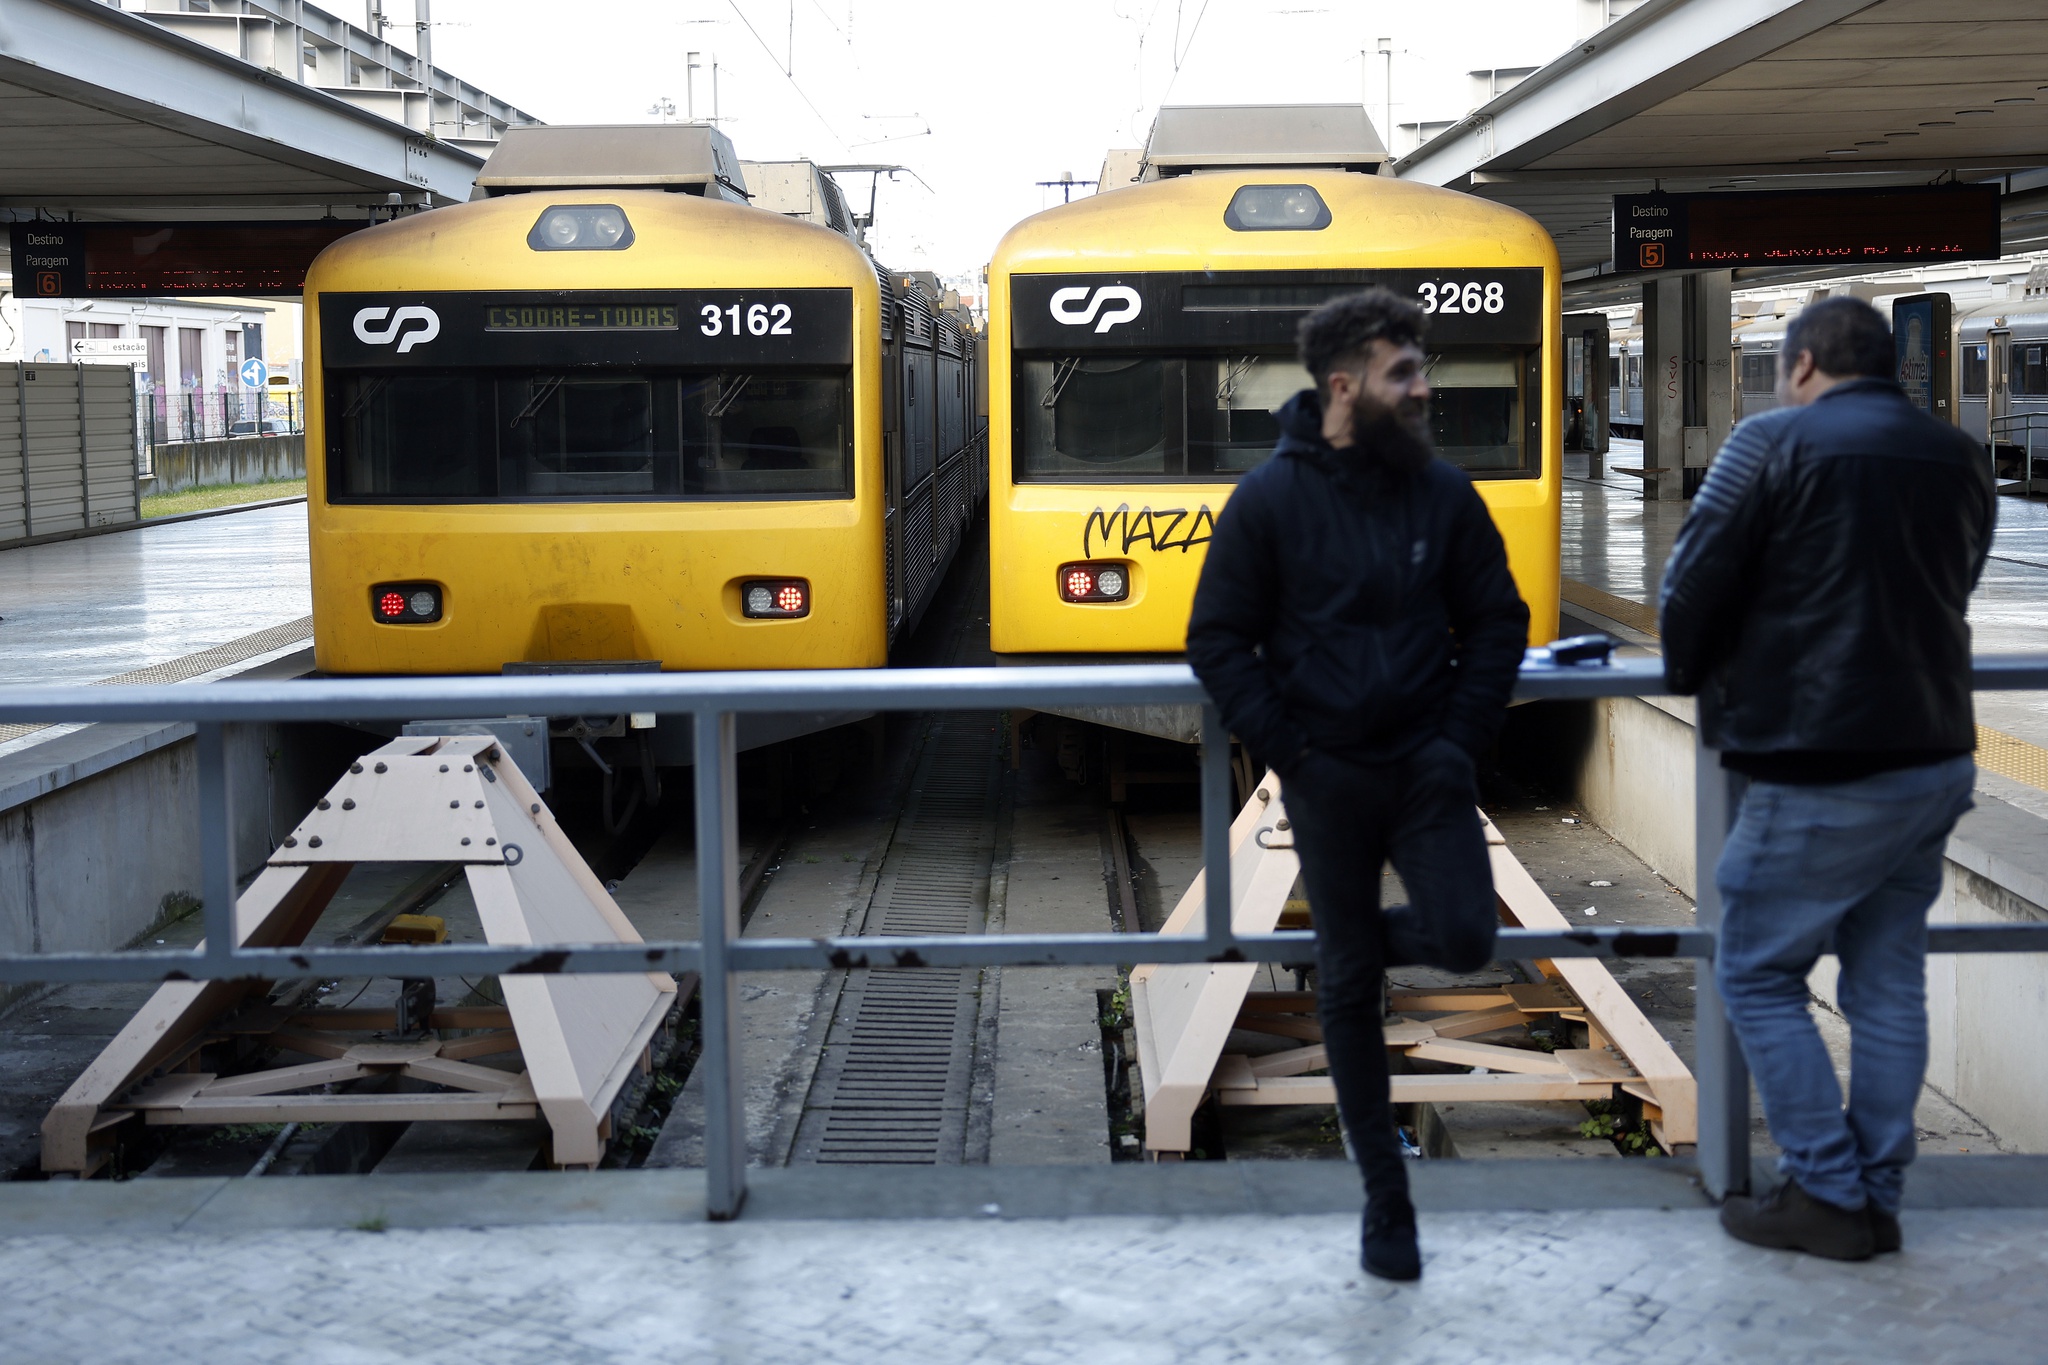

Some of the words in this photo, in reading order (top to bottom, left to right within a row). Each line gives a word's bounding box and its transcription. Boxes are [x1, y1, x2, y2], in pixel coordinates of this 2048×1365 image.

[1632, 204, 1669, 217] Destino
[27, 233, 64, 246] Destino
[1630, 226, 1673, 241] Paragem
[26, 254, 69, 269] Paragem
[1645, 246, 1659, 265] 5
[42, 274, 56, 293] 6
[1417, 281, 1505, 314] 3268
[699, 303, 793, 337] 3162
[112, 342, 146, 352] estação
